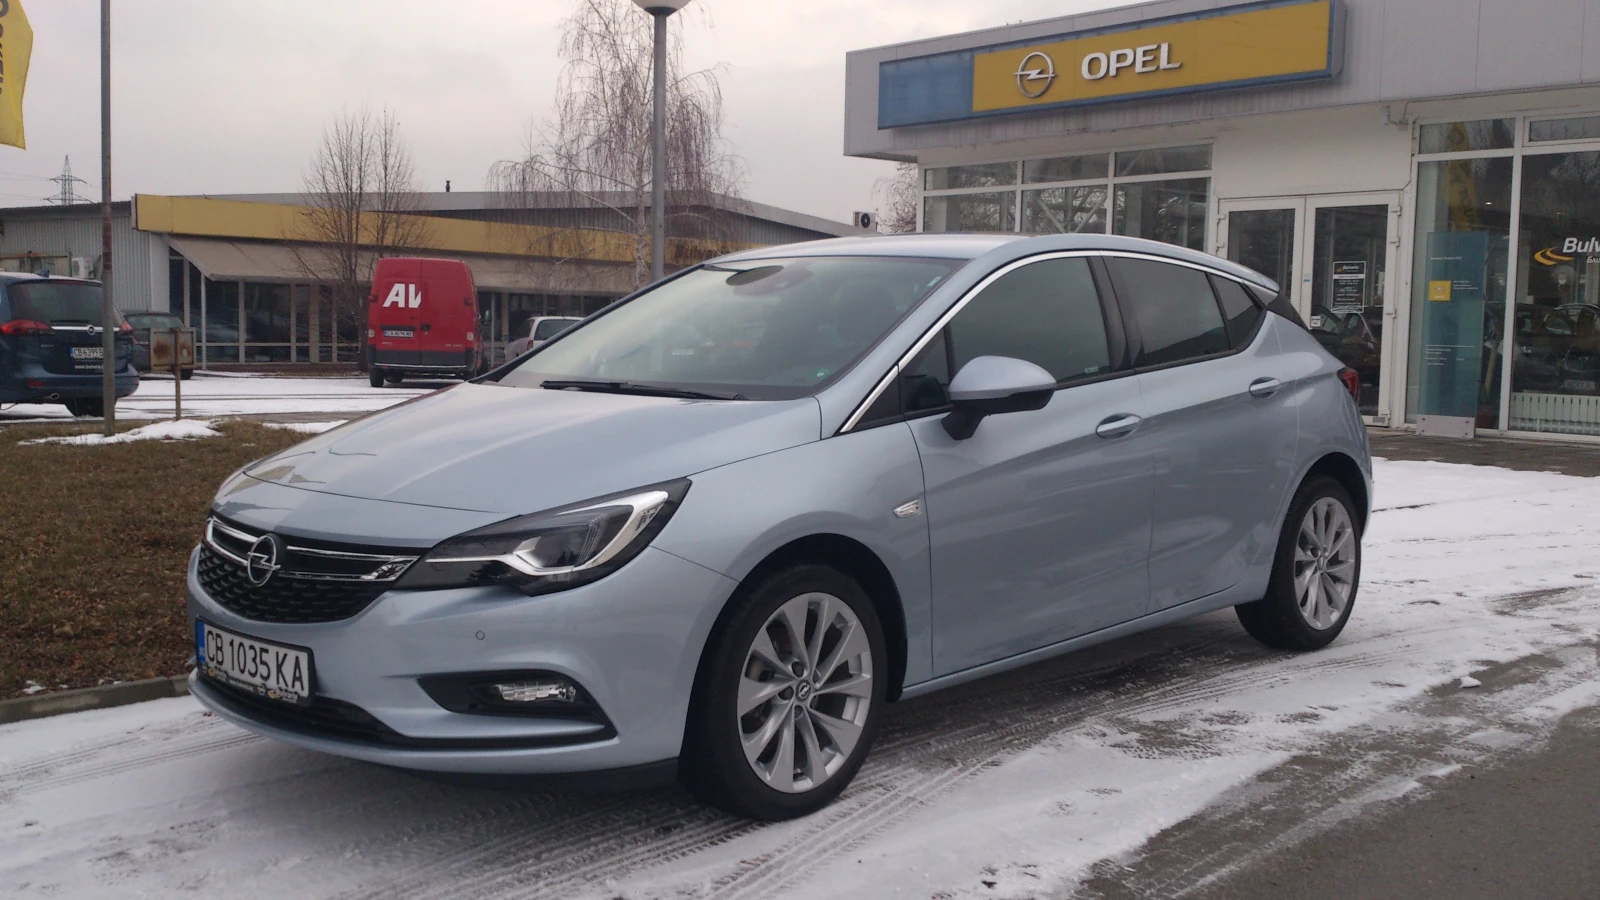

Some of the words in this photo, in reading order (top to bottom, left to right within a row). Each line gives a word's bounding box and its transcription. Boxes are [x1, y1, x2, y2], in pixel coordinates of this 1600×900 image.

[1081, 42, 1182, 80] OPEL
[73, 348, 82, 357] CB
[83, 348, 98, 357] 6399
[206, 630, 224, 666] CB
[229, 639, 271, 682] 1035
[275, 651, 304, 692] KA
